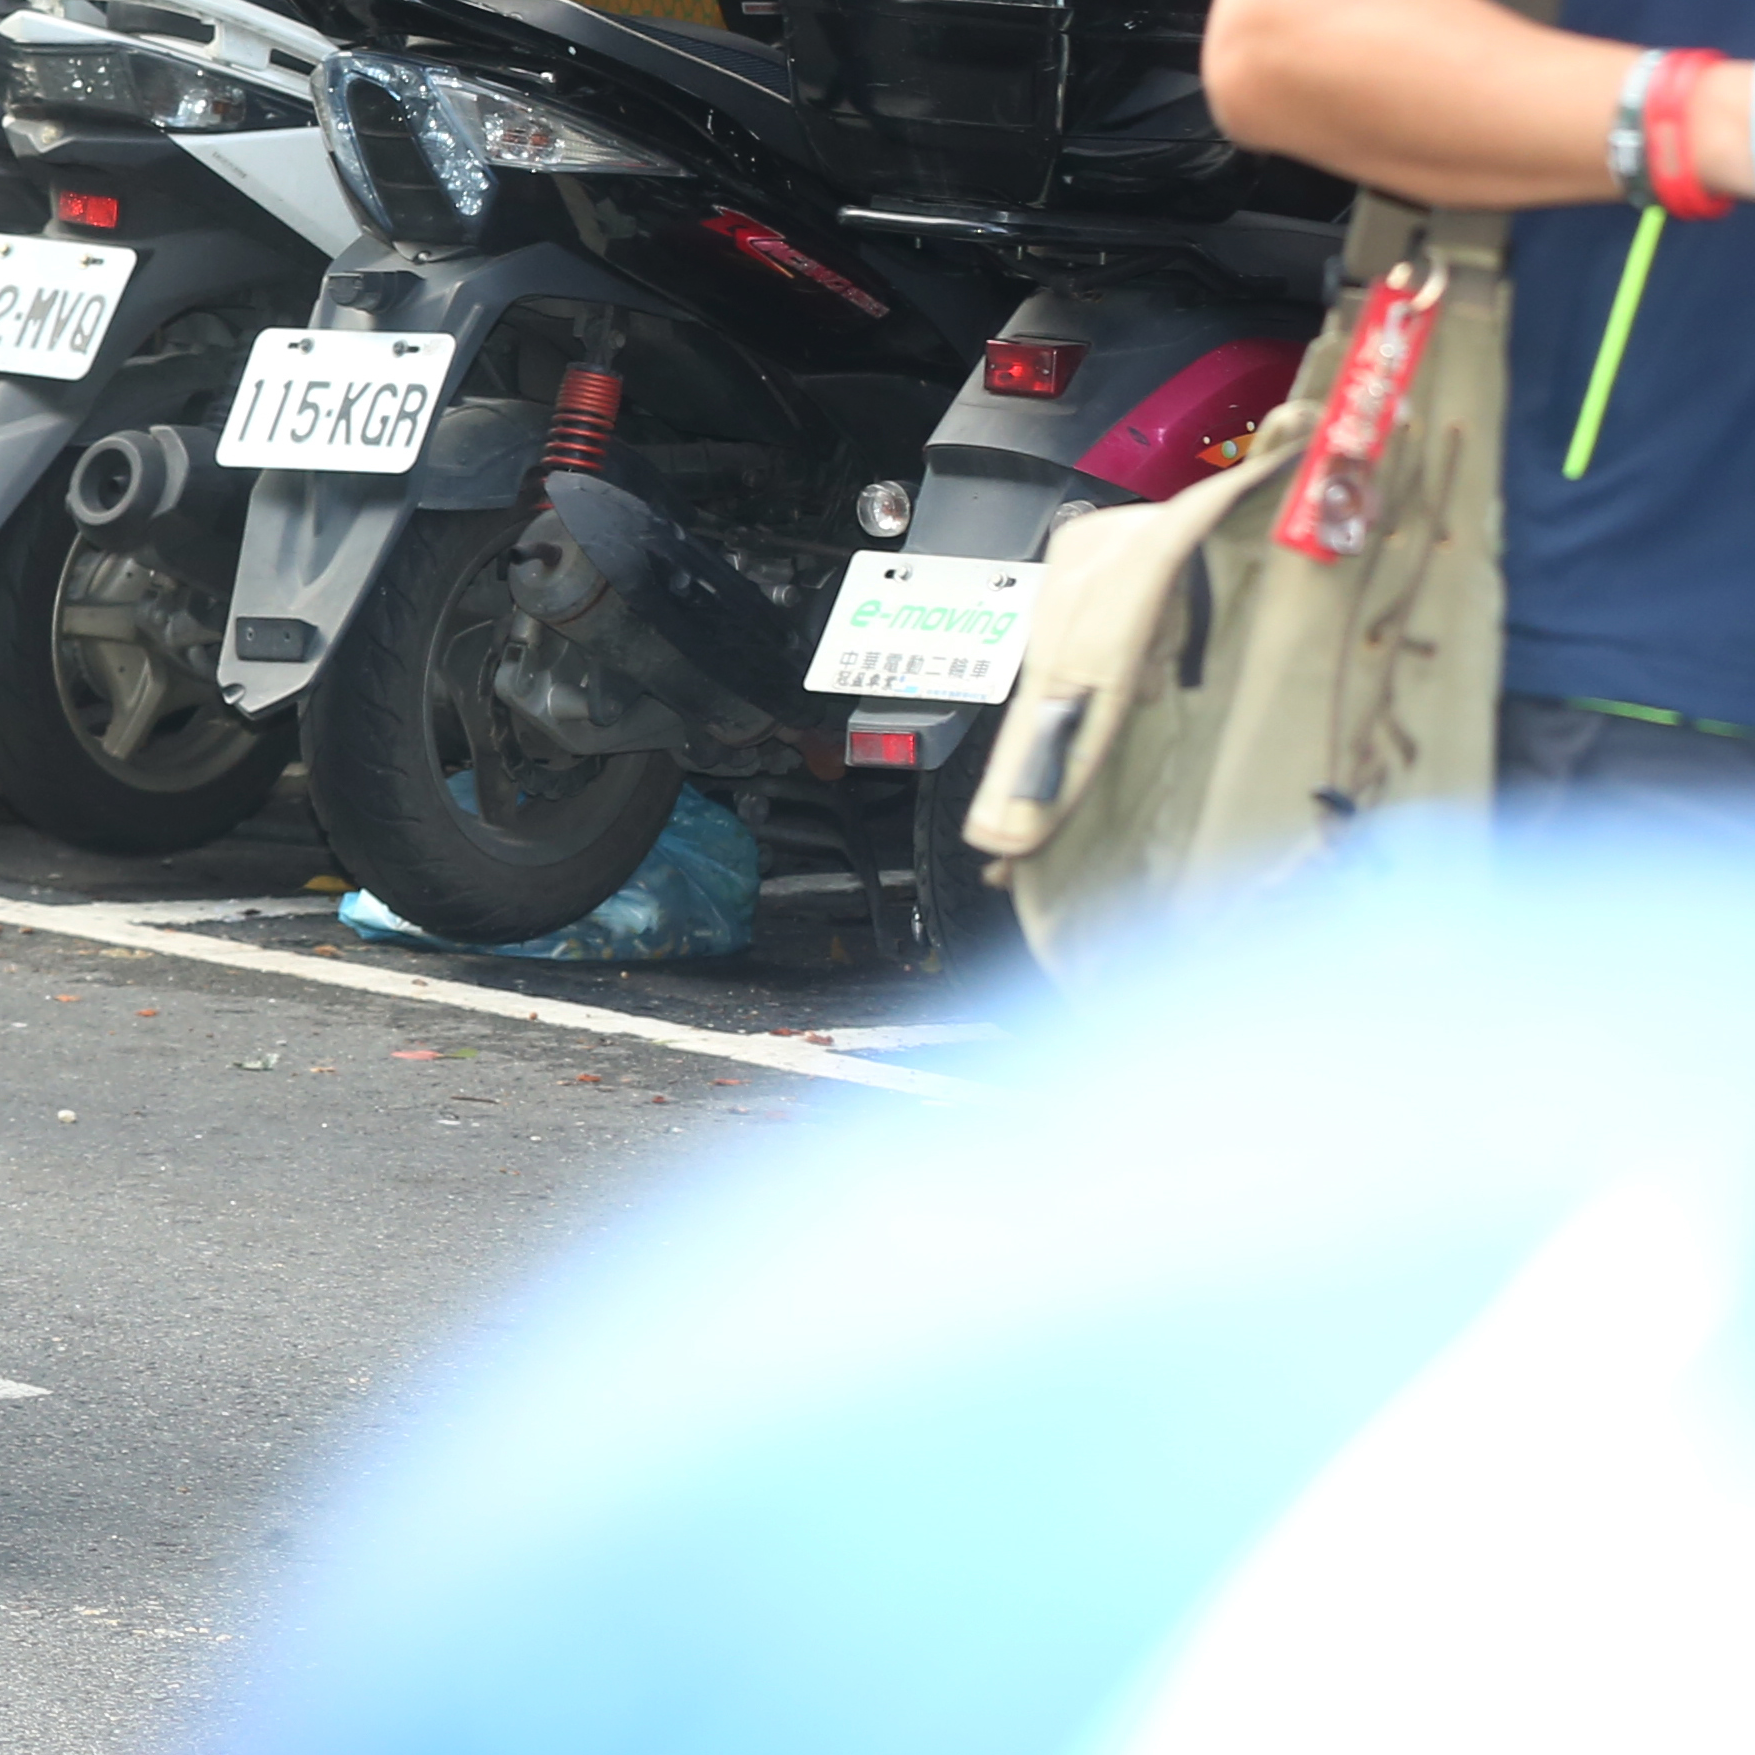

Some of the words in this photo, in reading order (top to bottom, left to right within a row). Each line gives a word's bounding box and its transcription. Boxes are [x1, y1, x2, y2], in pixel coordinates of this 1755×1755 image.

[238, 378, 429, 448] 115-KGR
[849, 598, 1019, 645] e-moving
[838, 650, 992, 680] 中華電動二輪車
